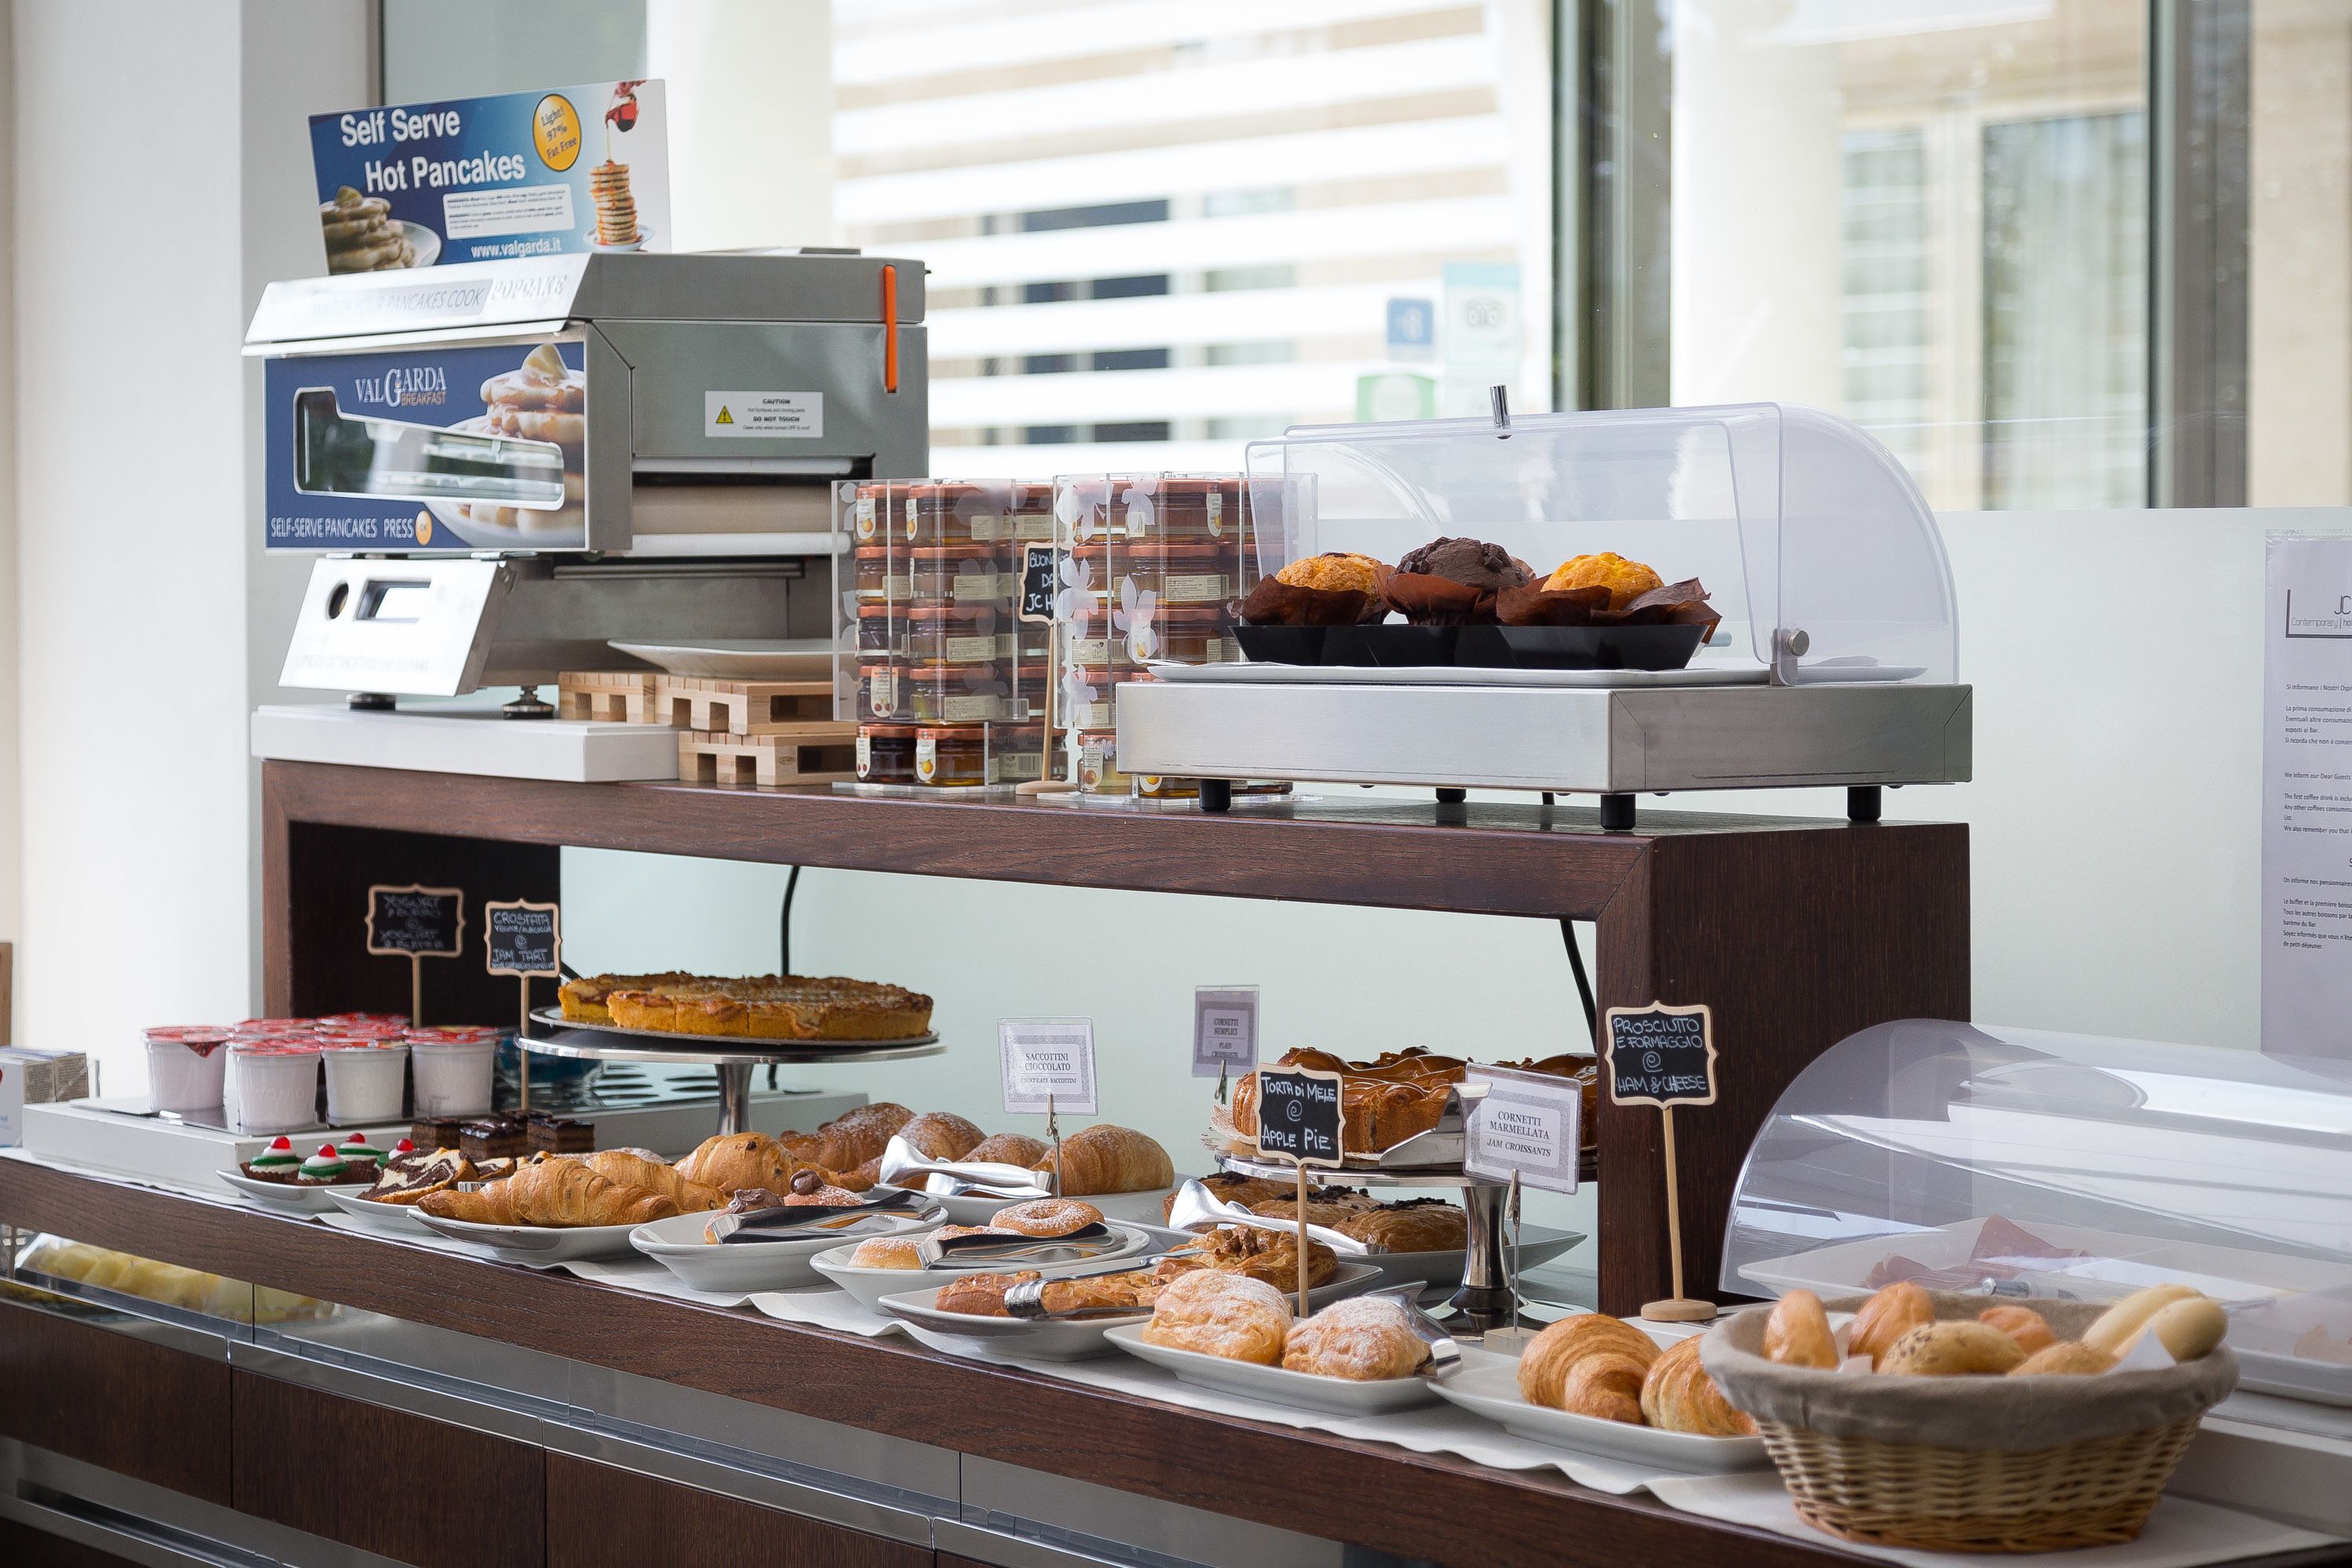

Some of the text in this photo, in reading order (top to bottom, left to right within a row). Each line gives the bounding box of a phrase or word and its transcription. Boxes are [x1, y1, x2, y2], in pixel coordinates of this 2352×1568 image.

[340, 108, 461, 147] Self Serve
[365, 150, 526, 193] Hot Pancakes
[471, 237, 561, 258] www.valgarda.it
[386, 290, 446, 313] PANCAKES
[447, 288, 485, 308] COOK
[401, 390, 446, 406] BREAKFAST
[270, 517, 324, 538] SELF-SERVE
[325, 517, 378, 539] PANCAKES
[383, 518, 415, 539] PRESS
[2292, 617, 2339, 629] Contemporary
[493, 911, 549, 925] CROSTATA
[492, 948, 548, 963] JAM TART
[1613, 1017, 1699, 1034] PROSCIUTTO
[1616, 1035, 1703, 1049] E FORMAGGIO
[1025, 1062, 1071, 1071] CIOCCOLATO
[1307, 1083, 1336, 1103] MELE
[1616, 1075, 1707, 1094] HAM & CHEESE
[1497, 1111, 1541, 1127] CORNETTI
[1261, 1123, 1297, 1148] APPLE
[1490, 1120, 1550, 1140] MARMELLATA
[1486, 1138, 1552, 1157] JAM CROISSANTS
